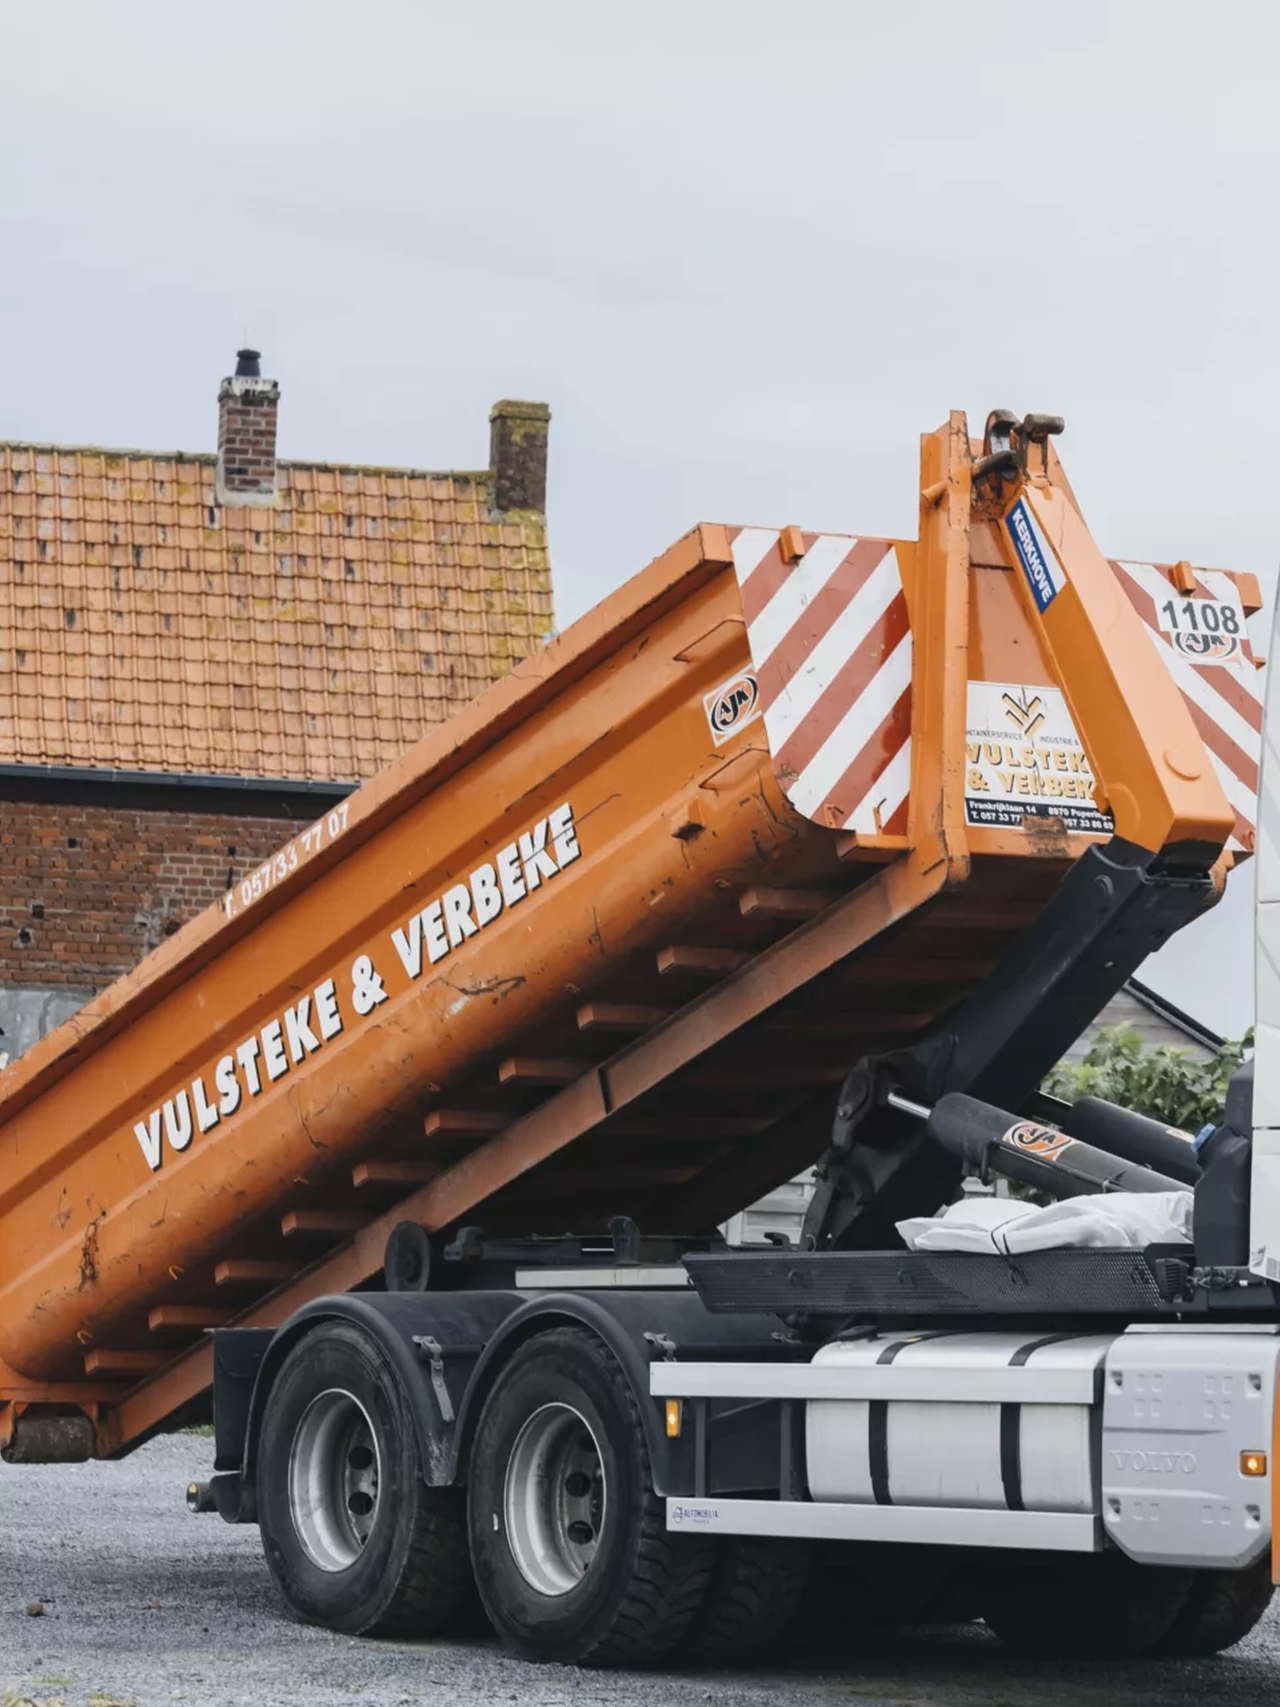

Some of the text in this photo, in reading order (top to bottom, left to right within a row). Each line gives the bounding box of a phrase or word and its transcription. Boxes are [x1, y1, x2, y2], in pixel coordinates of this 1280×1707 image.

[1012, 508, 1053, 603] KERKHOVE
[1161, 600, 1239, 634] 1108
[966, 729, 1023, 740] NTAINERSERVICE
[965, 742, 1090, 773] VULSTEK
[967, 768, 1094, 800] & VERBEK
[969, 801, 1025, 812] Frankrijklaan
[1026, 805, 1037, 814] 14
[1048, 807, 1069, 817] 8970
[971, 811, 979, 819] T.
[981, 812, 996, 821] 057
[998, 813, 1009, 822] 33
[1011, 814, 1021, 823] 77
[1079, 819, 1090, 828] 33
[241, 845, 298, 906] 057/33
[301, 822, 322, 852] 77
[328, 802, 349, 838] 07
[133, 802, 581, 1171] VULSTEKE & VERBEKE
[1109, 1449, 1197, 1475] VOLVO
